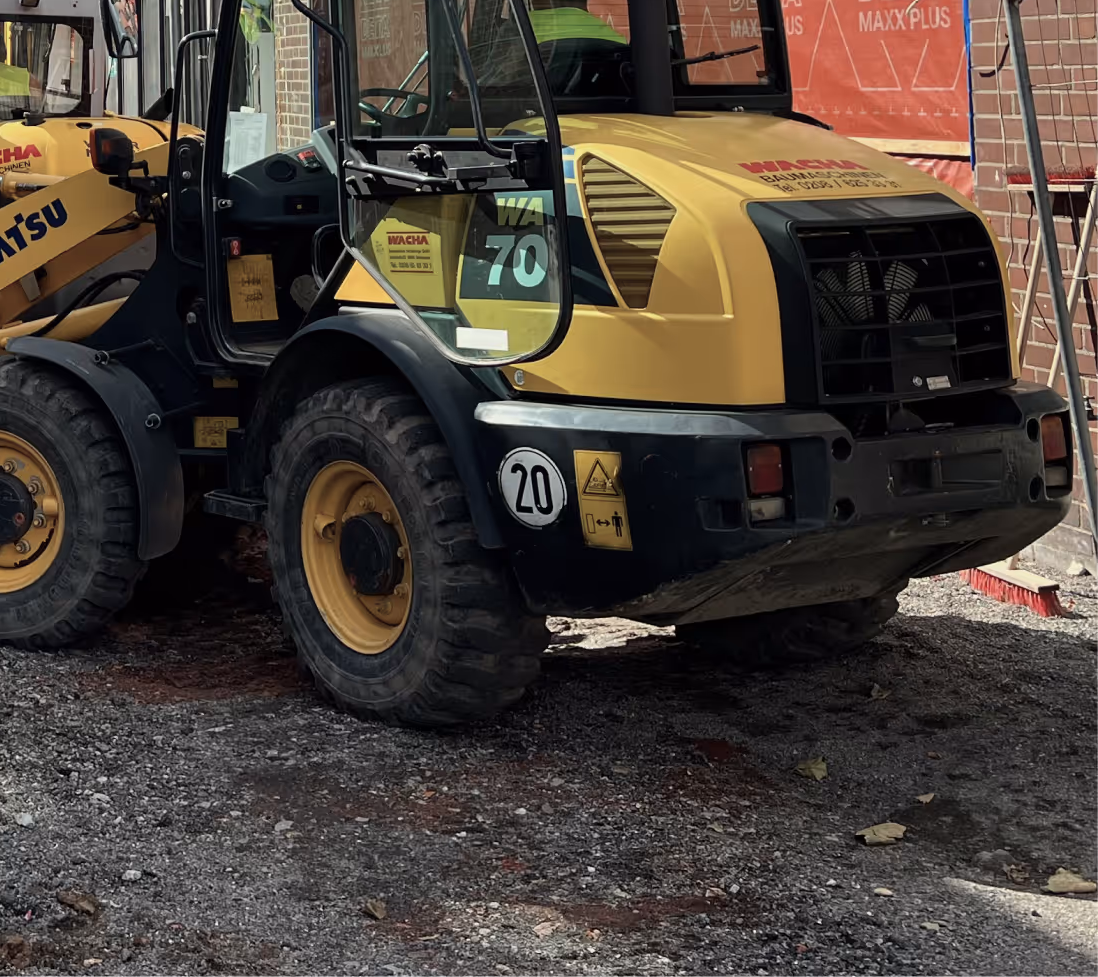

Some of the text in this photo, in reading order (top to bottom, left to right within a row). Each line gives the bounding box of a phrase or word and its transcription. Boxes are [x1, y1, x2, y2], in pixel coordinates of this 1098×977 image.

[859, 6, 951, 32] MAXX PLUS
[738, 159, 869, 173] WACHA
[496, 197, 544, 226] WA
[387, 235, 430, 245] WACHA
[485, 234, 549, 287] 70
[510, 463, 554, 516] 20
